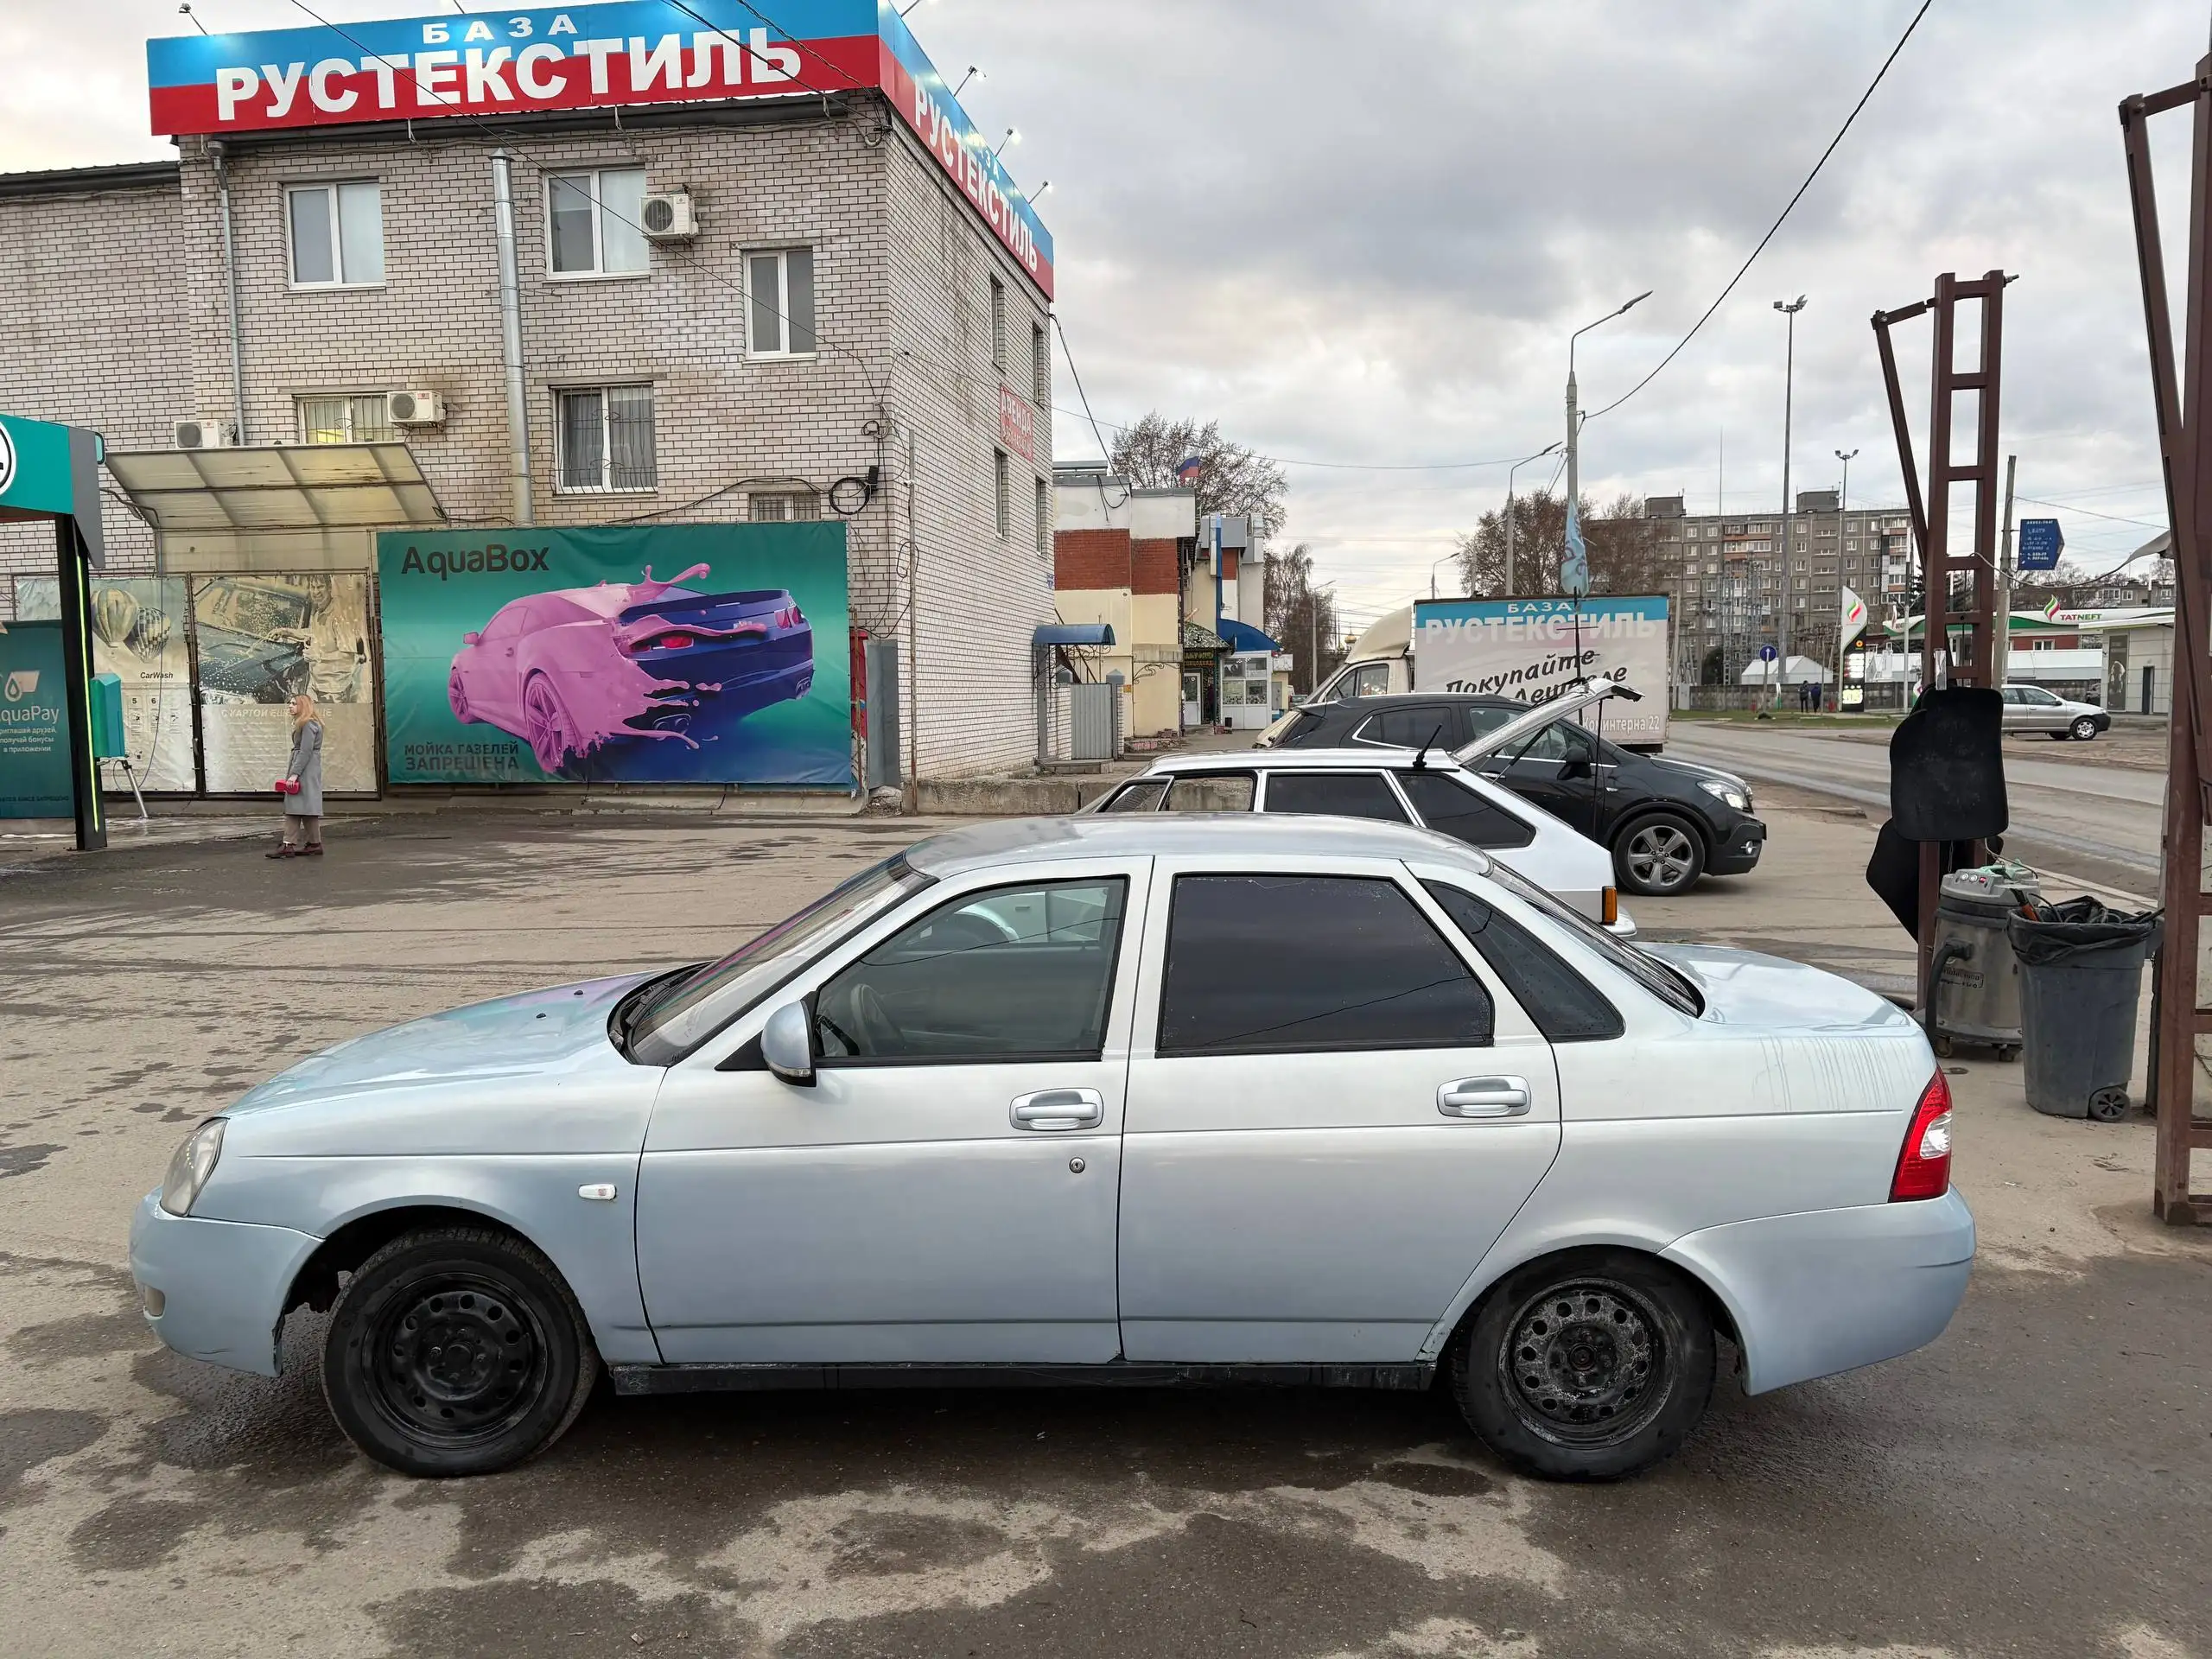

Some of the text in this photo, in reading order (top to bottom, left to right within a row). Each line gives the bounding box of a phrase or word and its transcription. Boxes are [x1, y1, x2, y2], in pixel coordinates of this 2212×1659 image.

[422, 15, 578, 45] БАЗА
[216, 27, 802, 121] РУСТЕКСТИЛЬ
[915, 74, 1037, 272] РУСТЕКСТИЛЬ
[401, 543, 550, 581] AquaBox
[1508, 602, 1573, 613] БАЗА
[1426, 612, 1658, 645] РУСТЕКСТИЛЬ
[1446, 650, 1594, 696] Покупайте
[0, 705, 60, 725] quaPay
[1648, 715, 1660, 731] 22
[404, 740, 519, 756] МОЙКА ГАЗЕЛЕЙ
[405, 756, 519, 771] ЗАПРЕЩЕНА
